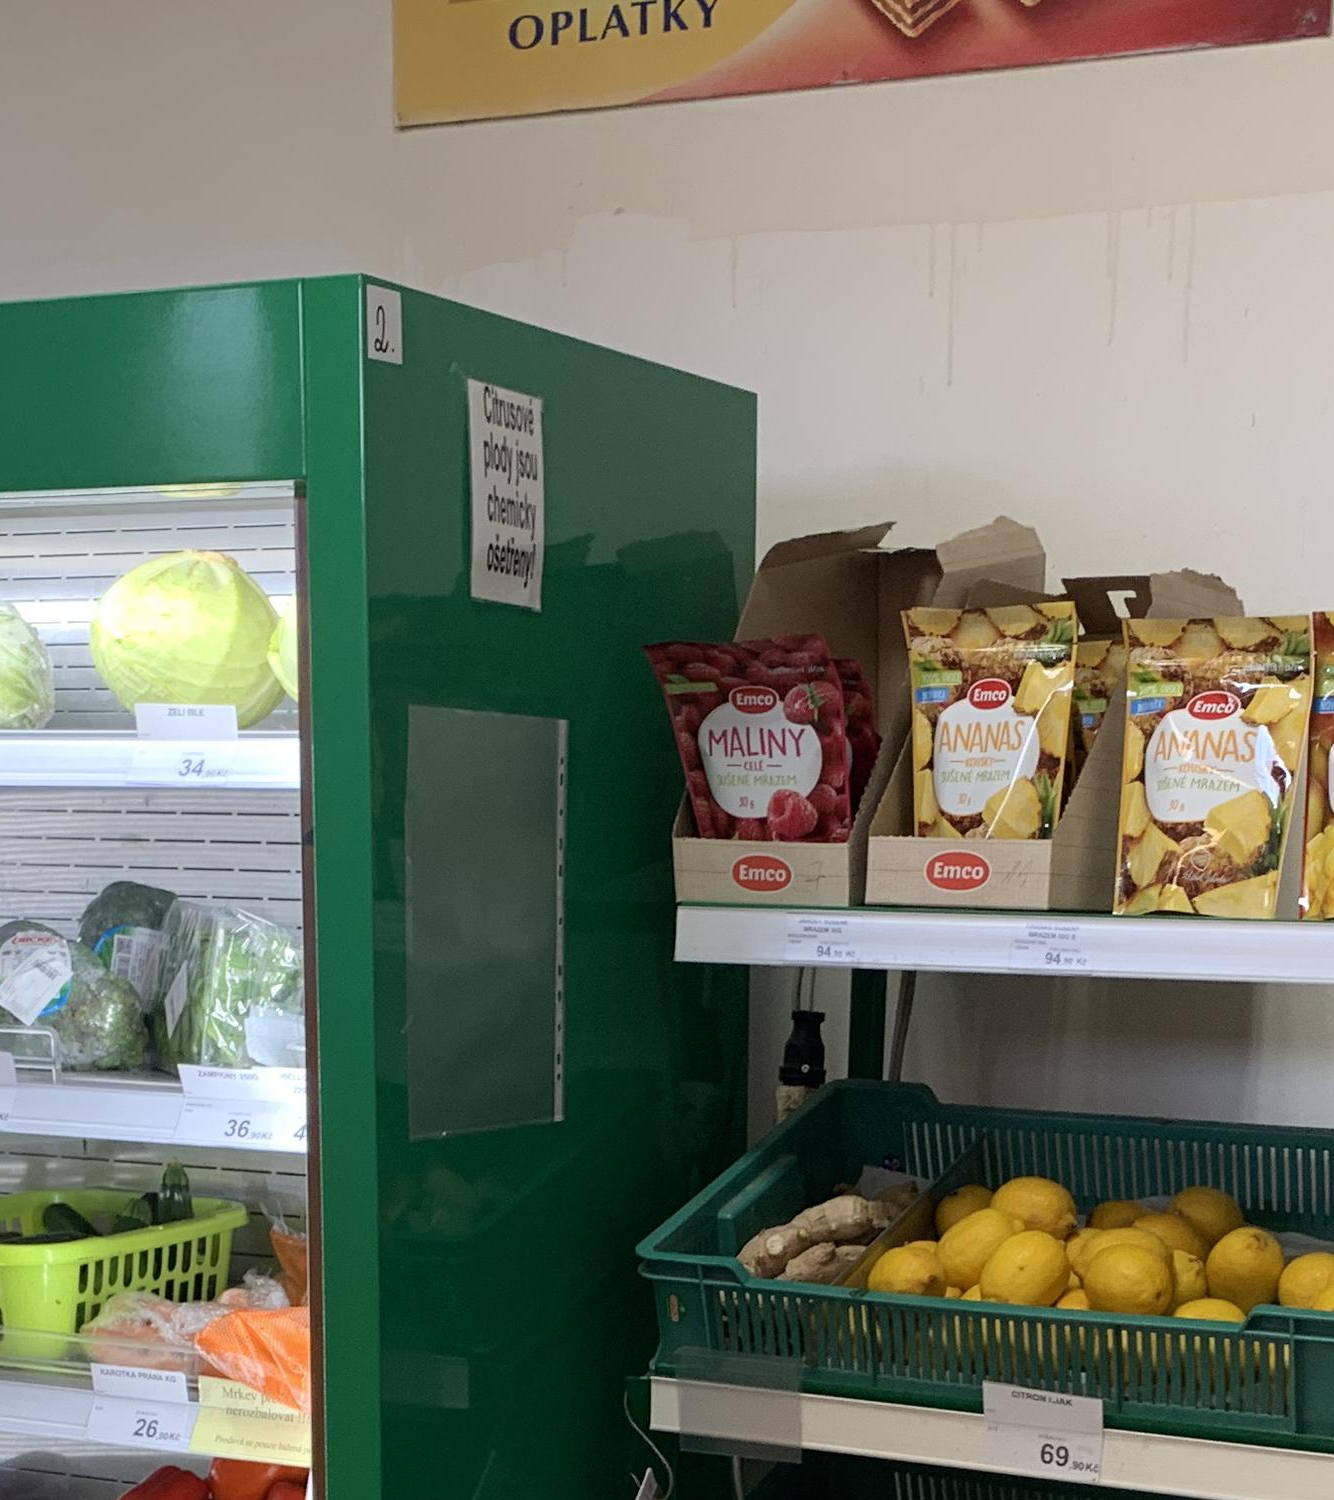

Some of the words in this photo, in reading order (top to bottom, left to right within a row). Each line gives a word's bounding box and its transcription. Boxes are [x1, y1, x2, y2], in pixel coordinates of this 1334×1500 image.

[509, 0, 718, 49] OPLATKY
[482, 385, 535, 437] Citrusové
[482, 431, 514, 485] plody
[515, 439, 538, 487] jsou
[485, 485, 537, 541] chemicky
[972, 688, 1008, 702] Emco
[1192, 699, 1237, 715] Emco
[707, 726, 807, 759] MALINY
[939, 720, 1027, 754] ANANAS
[1153, 729, 1259, 764] ANANAS
[737, 862, 788, 884] Emco
[932, 860, 986, 883] Emco
[99, 1368, 137, 1380] KAROTKA
[221, 1386, 258, 1401] Mrkev
[1011, 1389, 1047, 1402] CITRON
[225, 1405, 295, 1423] nerozbalovat
